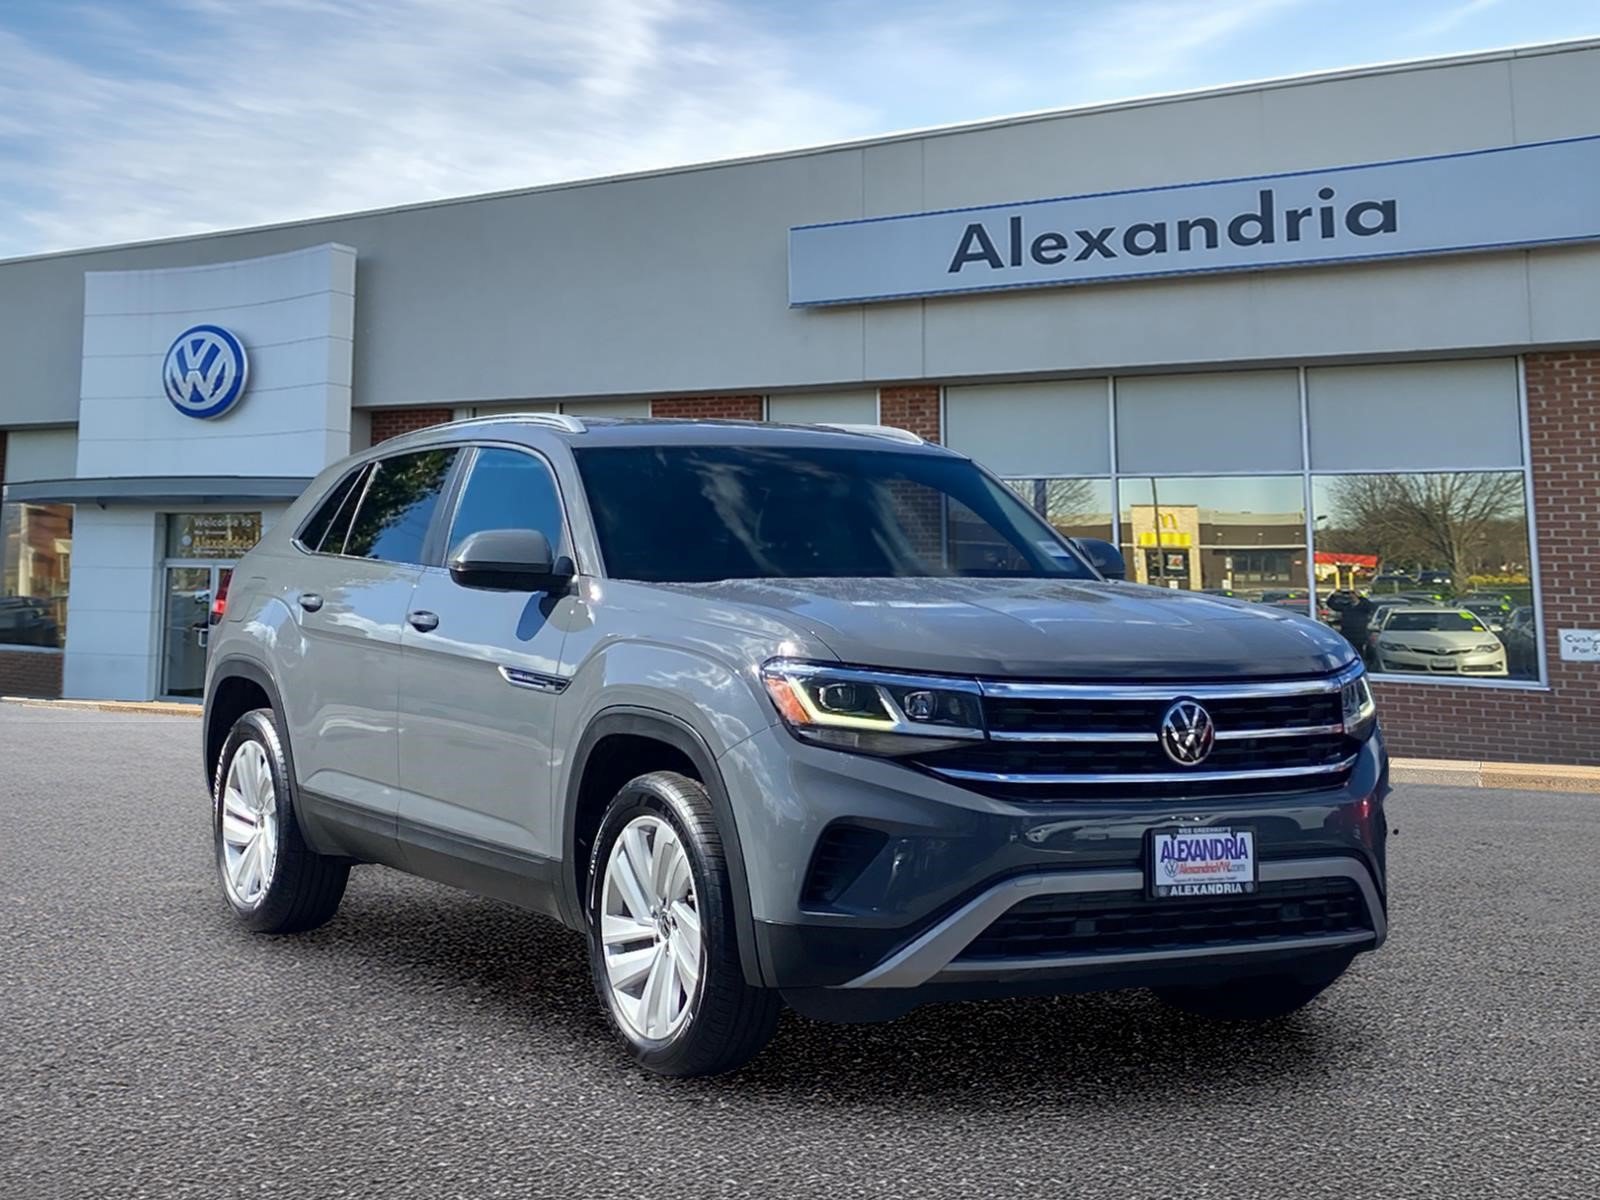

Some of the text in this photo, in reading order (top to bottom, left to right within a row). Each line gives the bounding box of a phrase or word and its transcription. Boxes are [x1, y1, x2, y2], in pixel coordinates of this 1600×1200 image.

[947, 189, 1398, 273] Alexandria
[1161, 838, 1248, 863] ALEXANDRIA
[1170, 883, 1242, 896] ALEXANDRIA
